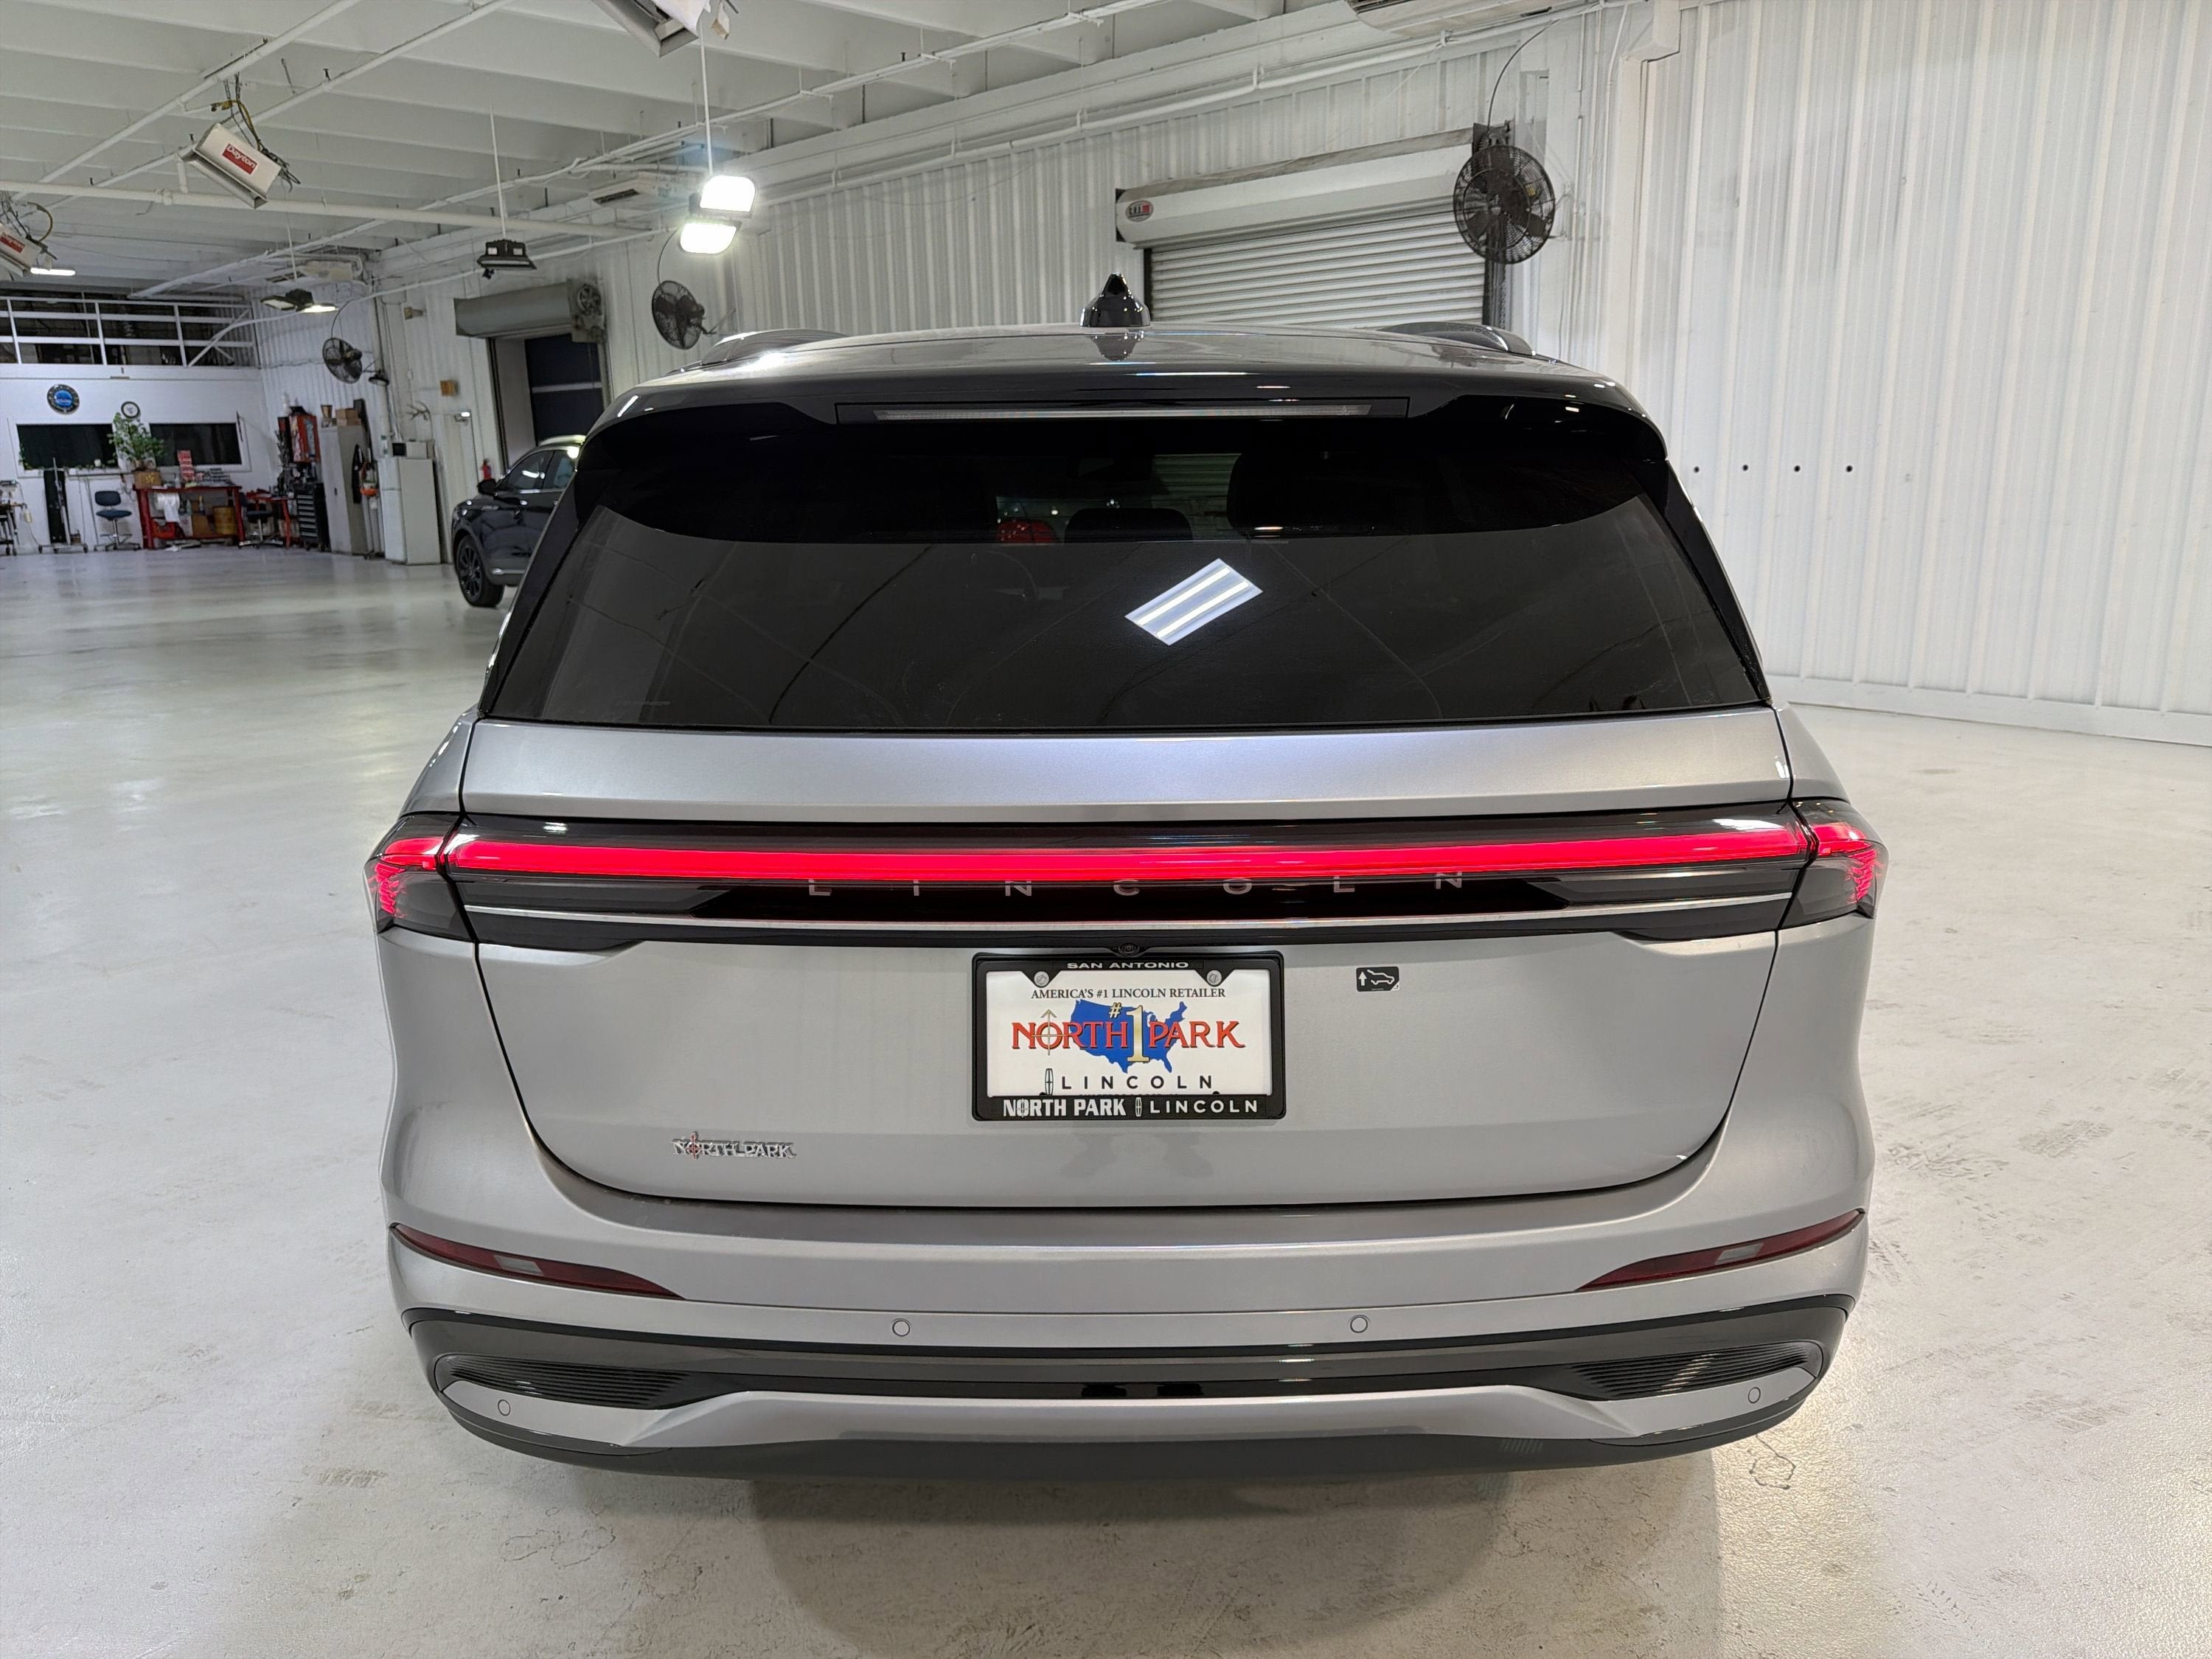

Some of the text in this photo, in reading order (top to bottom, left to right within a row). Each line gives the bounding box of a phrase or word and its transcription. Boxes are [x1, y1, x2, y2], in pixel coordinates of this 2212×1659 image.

[226, 145, 257, 170] Dayton
[808, 872, 1462, 897] LINCOLN
[1096, 990, 1109, 998] #1
[1112, 988, 1166, 998] LINCOLN
[1169, 988, 1227, 998] RETAILER
[1012, 1020, 1247, 1050] NORTH PARK
[1062, 1075, 1212, 1090] LINCOLN
[1003, 1099, 1258, 1117] NORTH PARK LINCOLN
